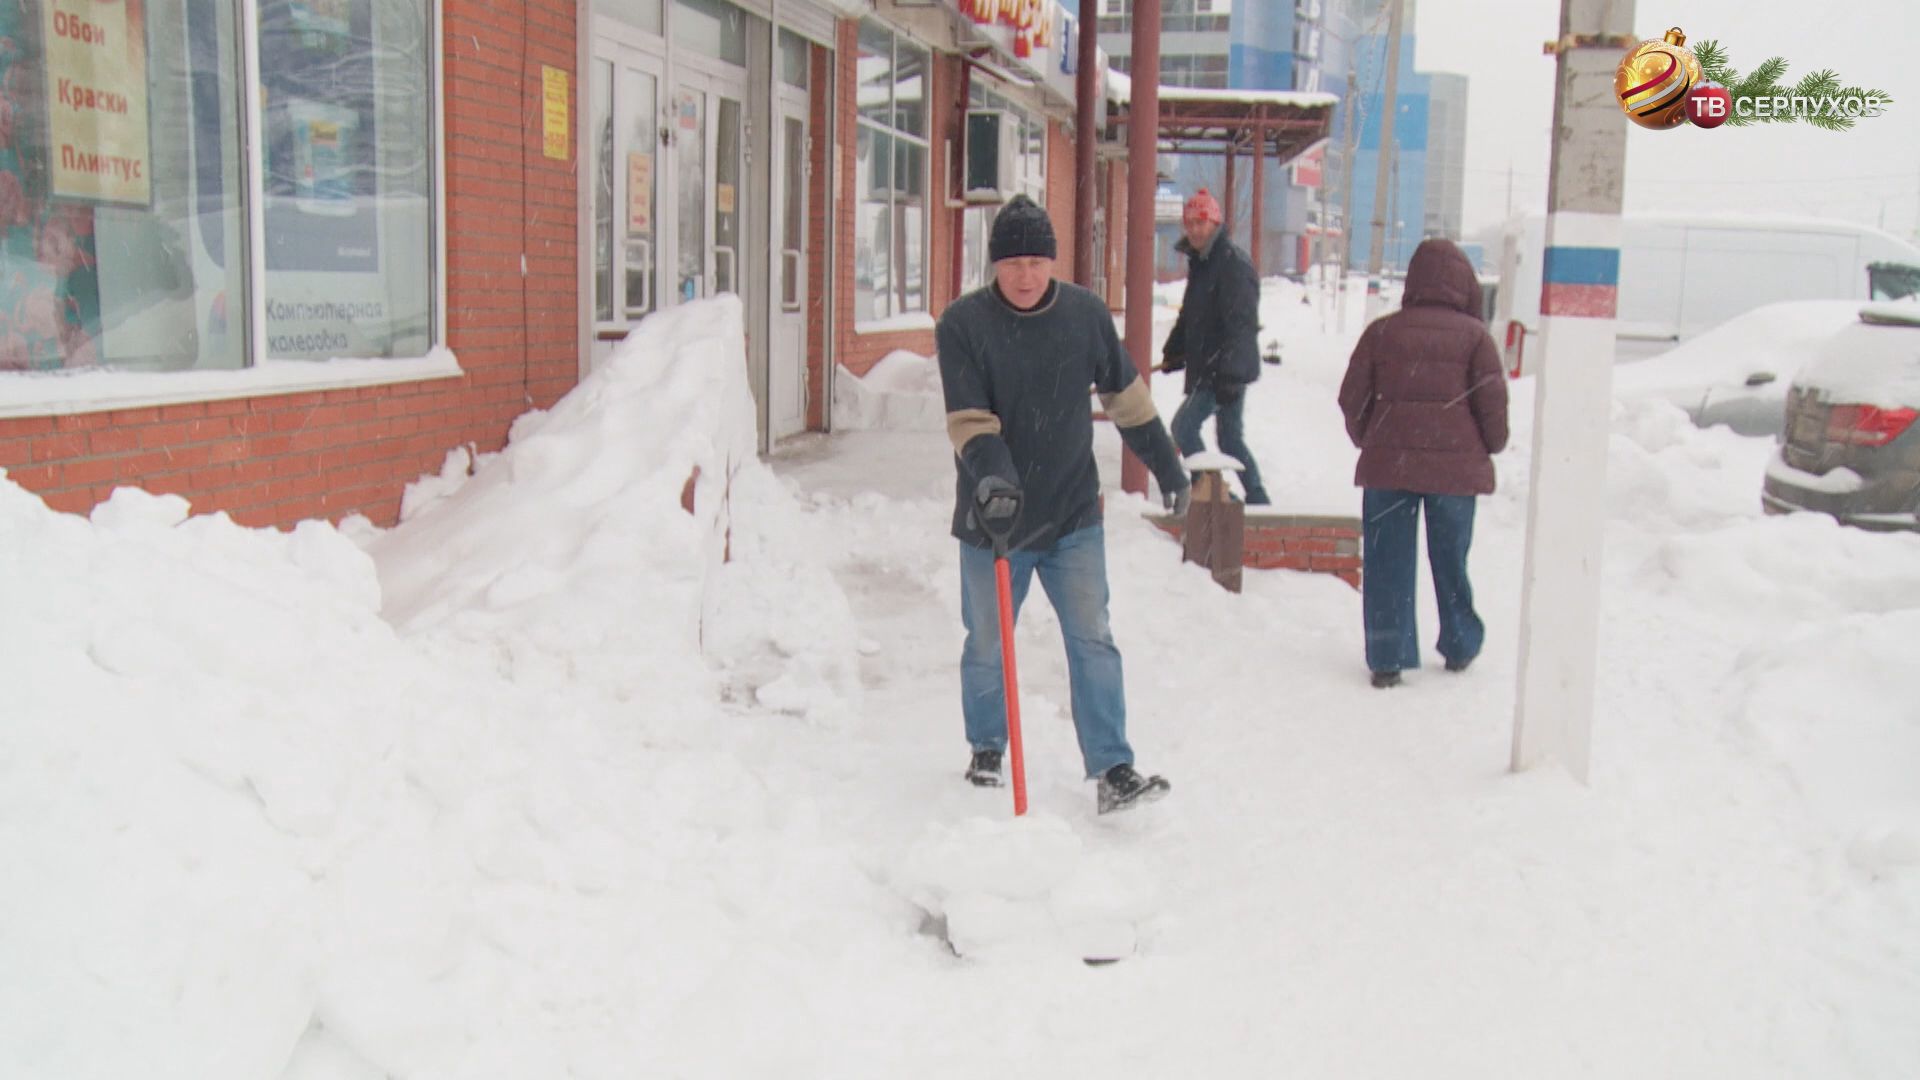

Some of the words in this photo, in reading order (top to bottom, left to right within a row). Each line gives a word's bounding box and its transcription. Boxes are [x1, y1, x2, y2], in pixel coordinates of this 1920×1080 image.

[54, 10, 105, 46] Обои
[58, 77, 128, 114] Краски
[61, 144, 142, 182] Плинтус
[266, 298, 382, 324] Компьютерная
[268, 328, 348, 355] колеровка
